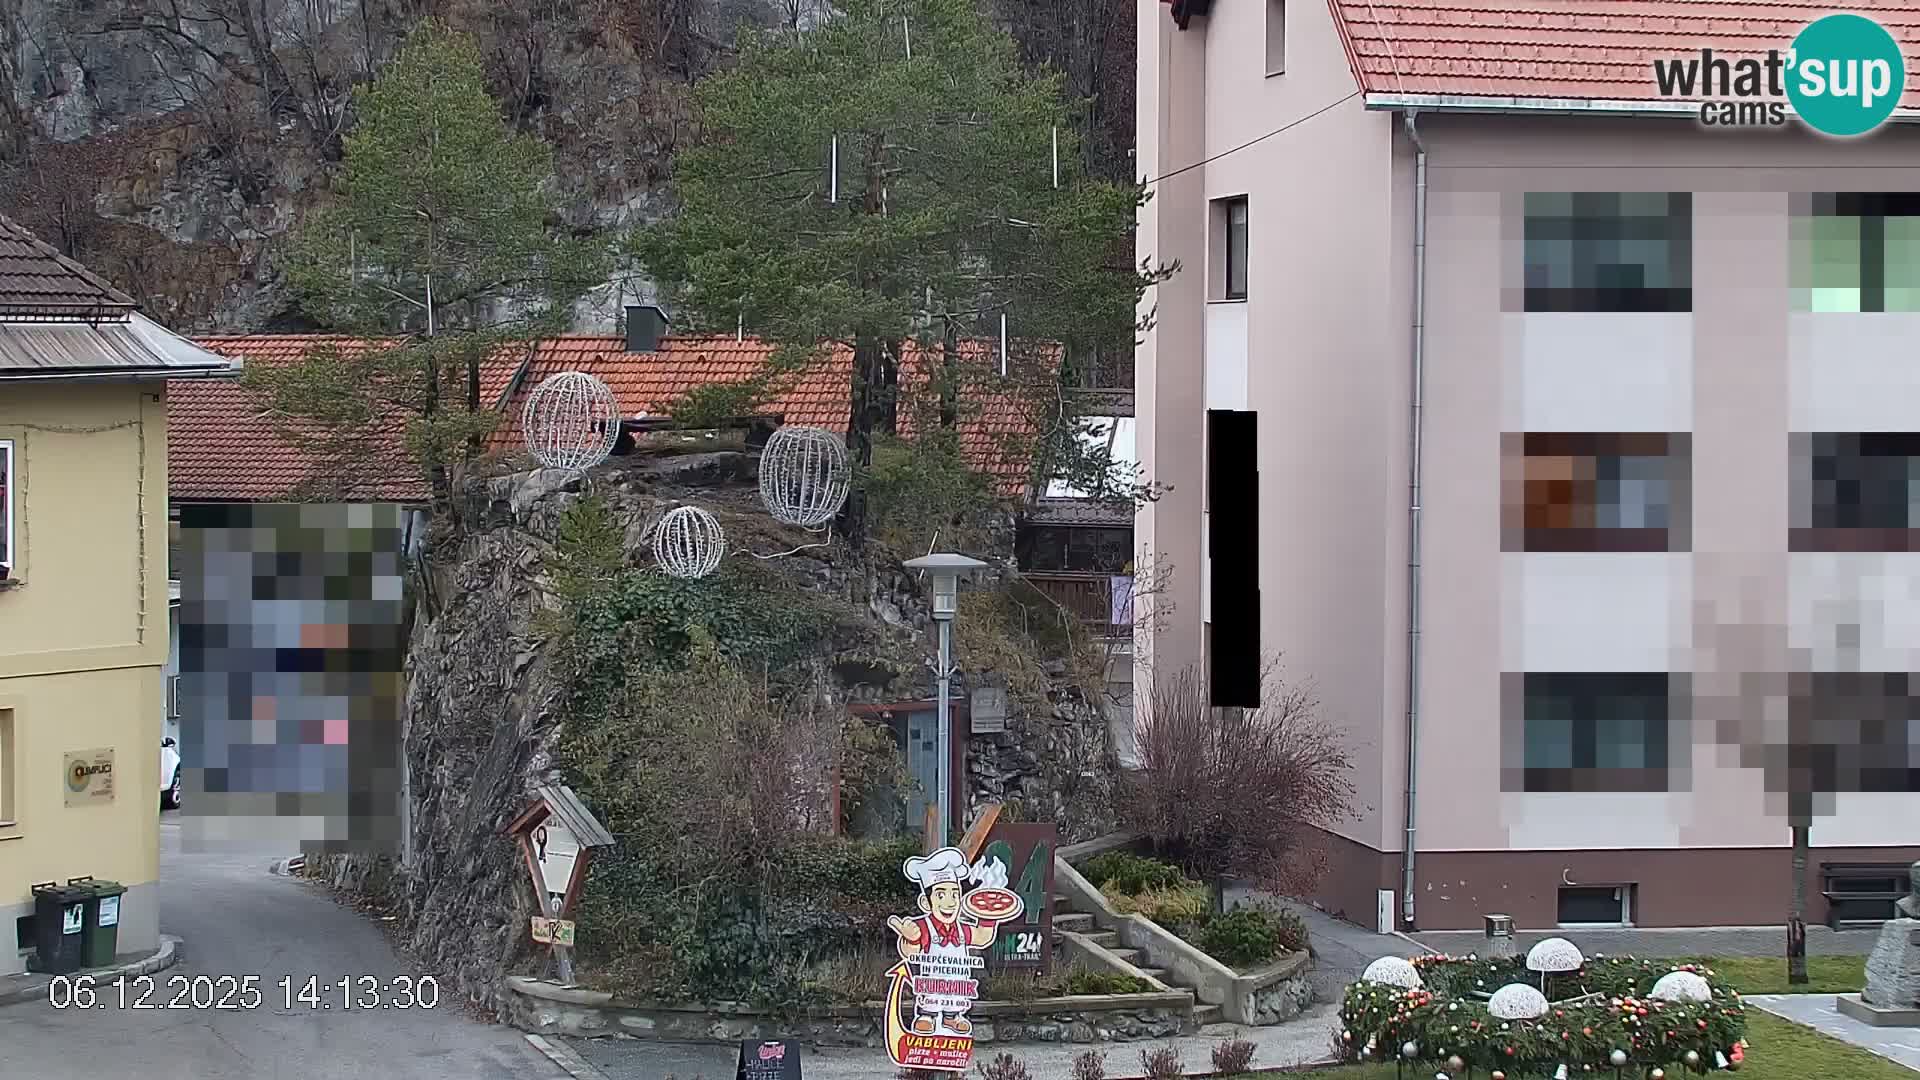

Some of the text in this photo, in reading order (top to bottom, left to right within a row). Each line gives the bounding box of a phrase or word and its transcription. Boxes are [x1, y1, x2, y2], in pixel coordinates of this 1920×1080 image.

[922, 965, 969, 976] IN PICERIJA
[914, 978, 978, 997] KURNIK
[906, 1036, 972, 1050] VABLJENI
